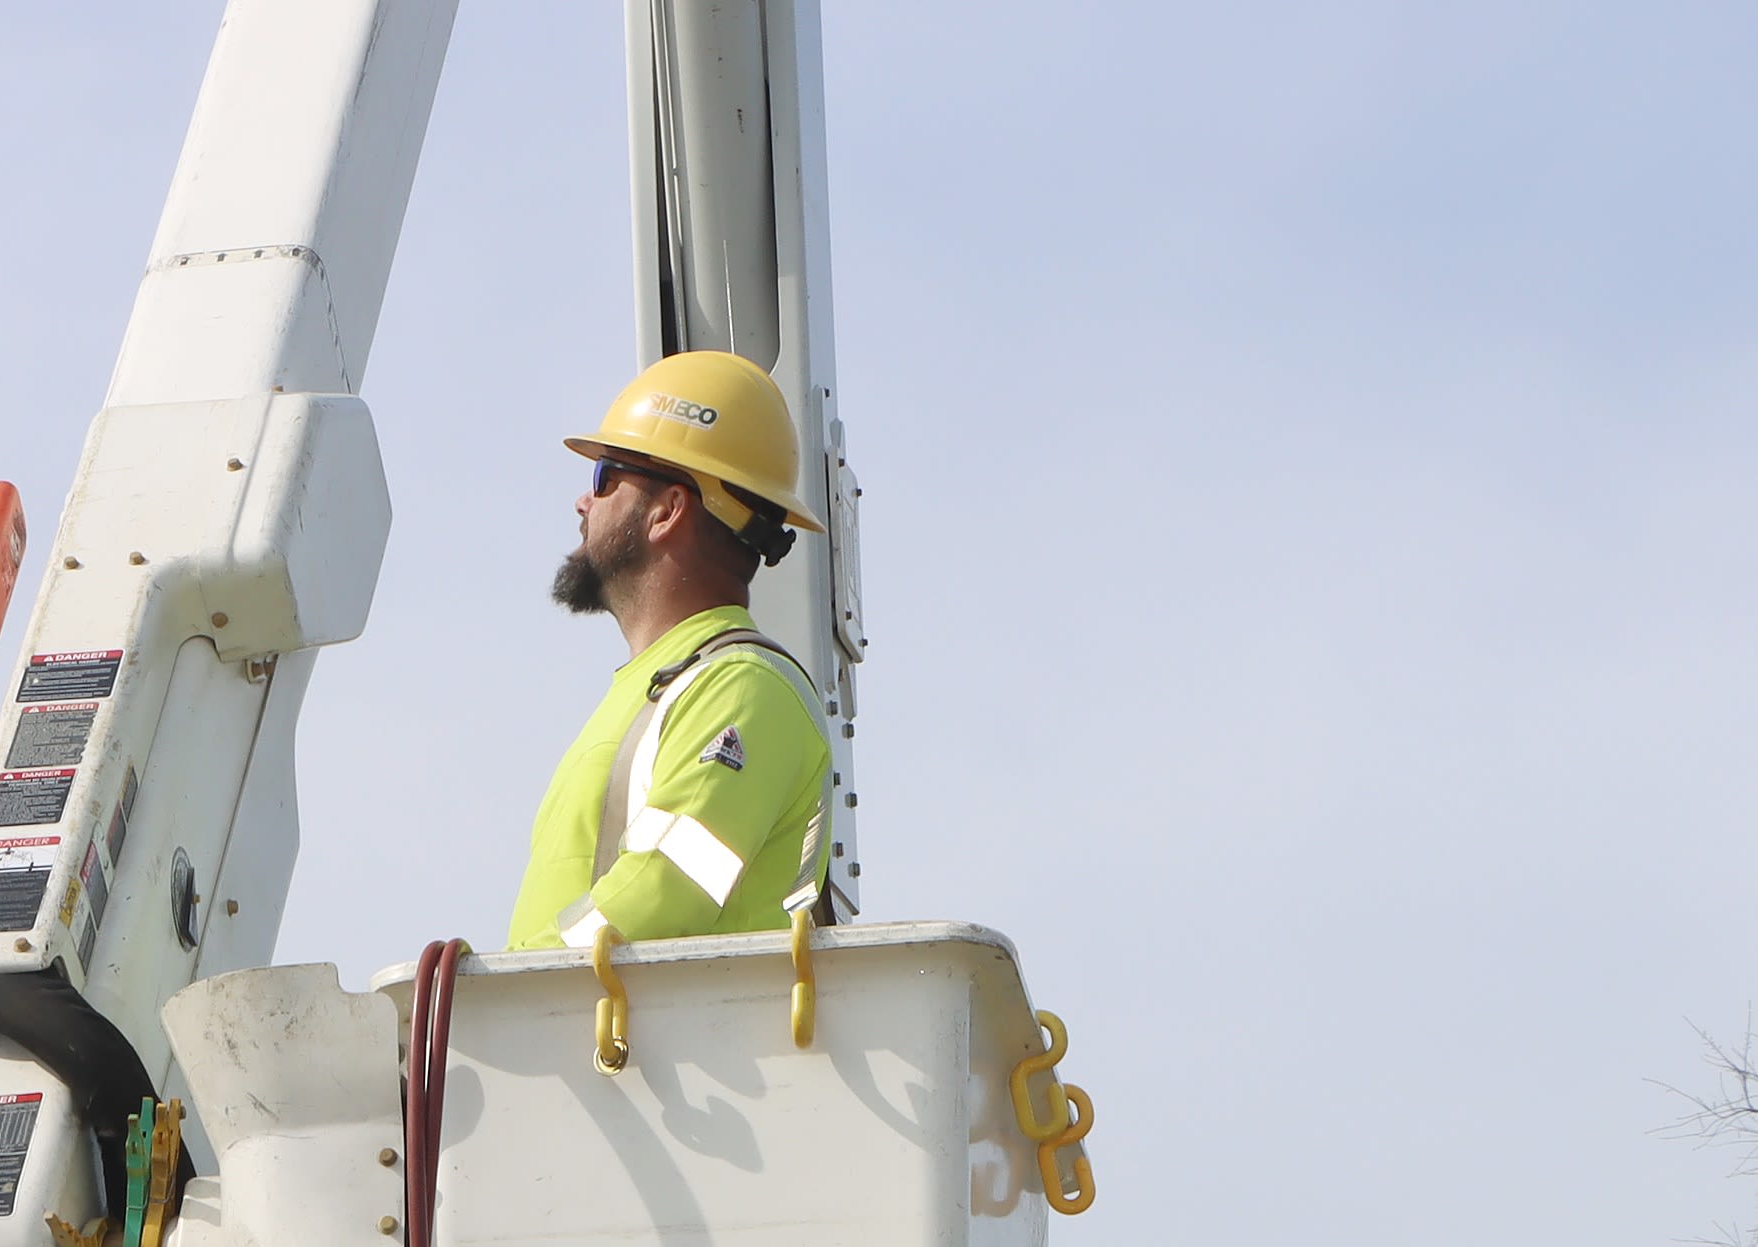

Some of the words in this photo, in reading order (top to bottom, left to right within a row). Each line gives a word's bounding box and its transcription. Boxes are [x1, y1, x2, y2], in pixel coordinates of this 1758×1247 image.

[650, 393, 717, 425] SMECO
[55, 651, 107, 661] DANGER
[46, 703, 94, 712] DANGER
[21, 770, 61, 779] DANGER
